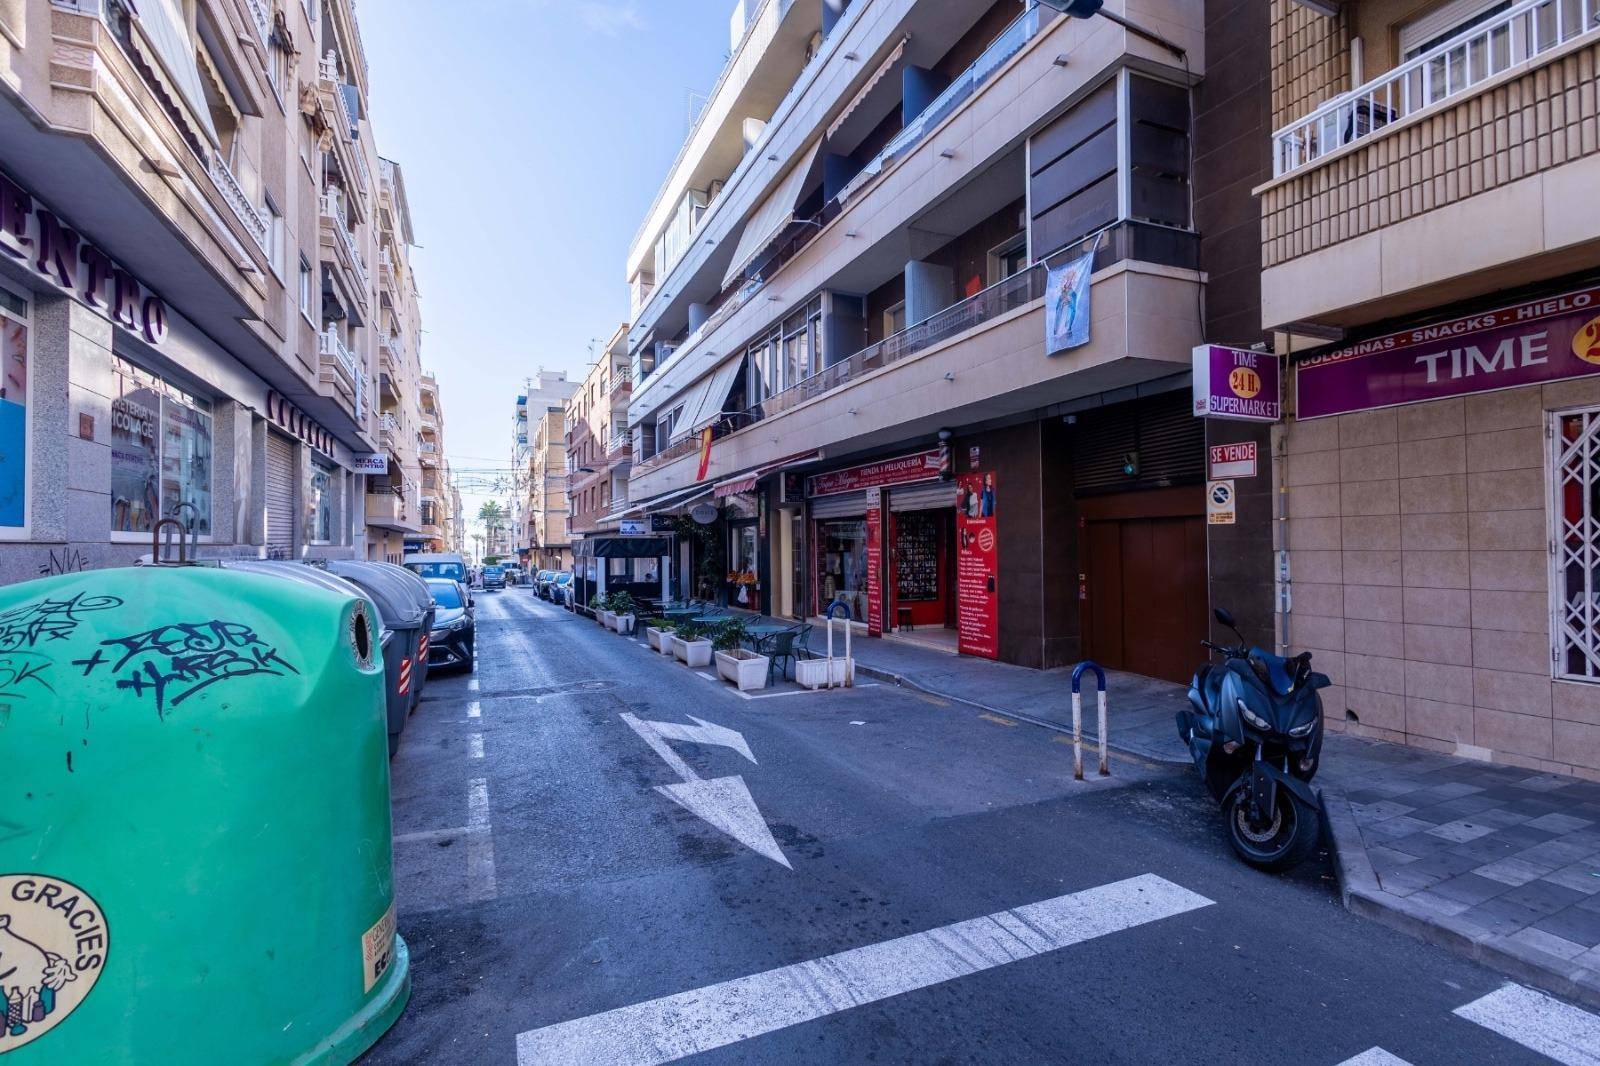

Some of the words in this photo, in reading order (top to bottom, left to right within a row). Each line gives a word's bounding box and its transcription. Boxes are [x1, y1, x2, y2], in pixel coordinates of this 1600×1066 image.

[1412, 315, 1496, 342] SNACKS
[1517, 294, 1591, 319] HIELO
[1231, 350, 1257, 368] TIME
[1415, 331, 1548, 384] TIME
[1232, 371, 1245, 391] 24
[1210, 395, 1278, 417] SUPERMARKET
[1212, 447, 1222, 463] SE
[1224, 444, 1254, 461] VENDE
[11, 879, 104, 972] GRACIES
